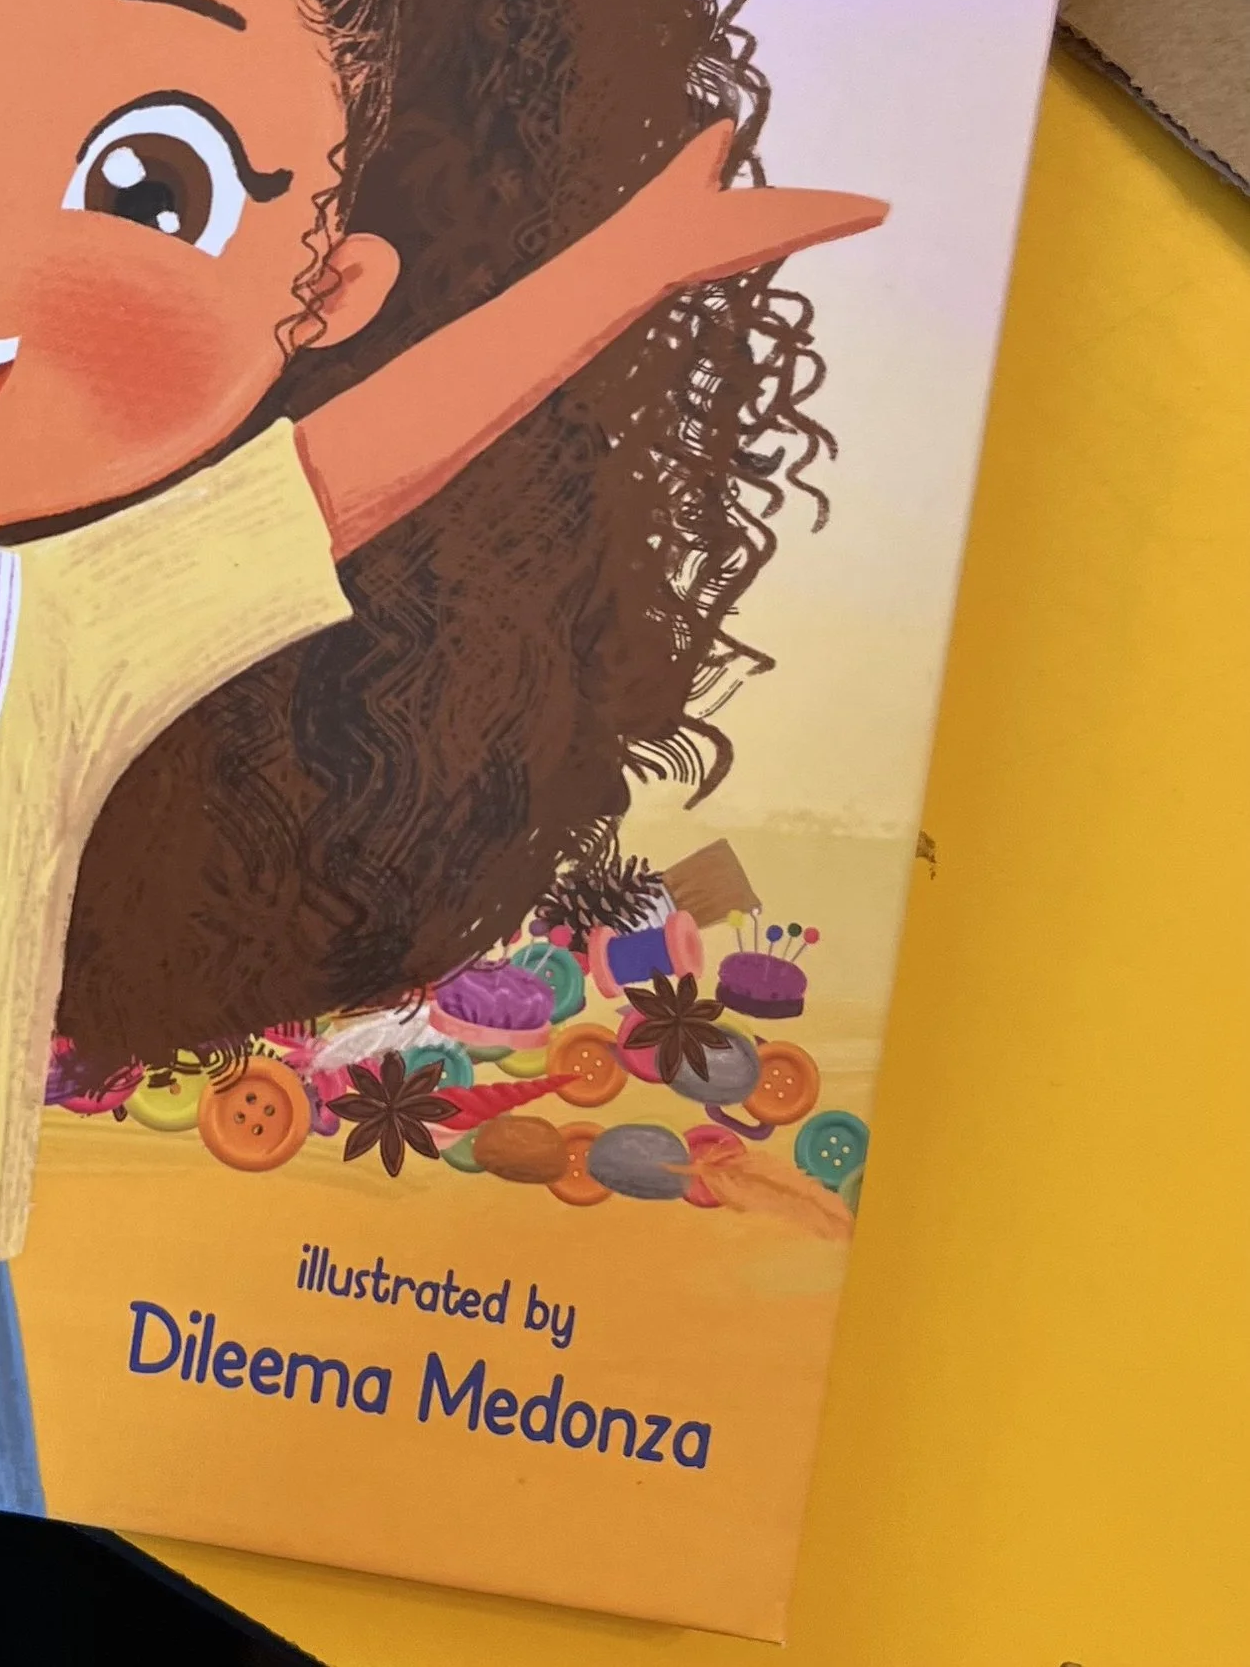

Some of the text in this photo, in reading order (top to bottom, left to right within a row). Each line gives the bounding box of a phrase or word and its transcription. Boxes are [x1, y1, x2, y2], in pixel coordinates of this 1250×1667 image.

[297, 1244, 575, 1349] illustrated by
[129, 1301, 711, 1469] Dileema Medonza
